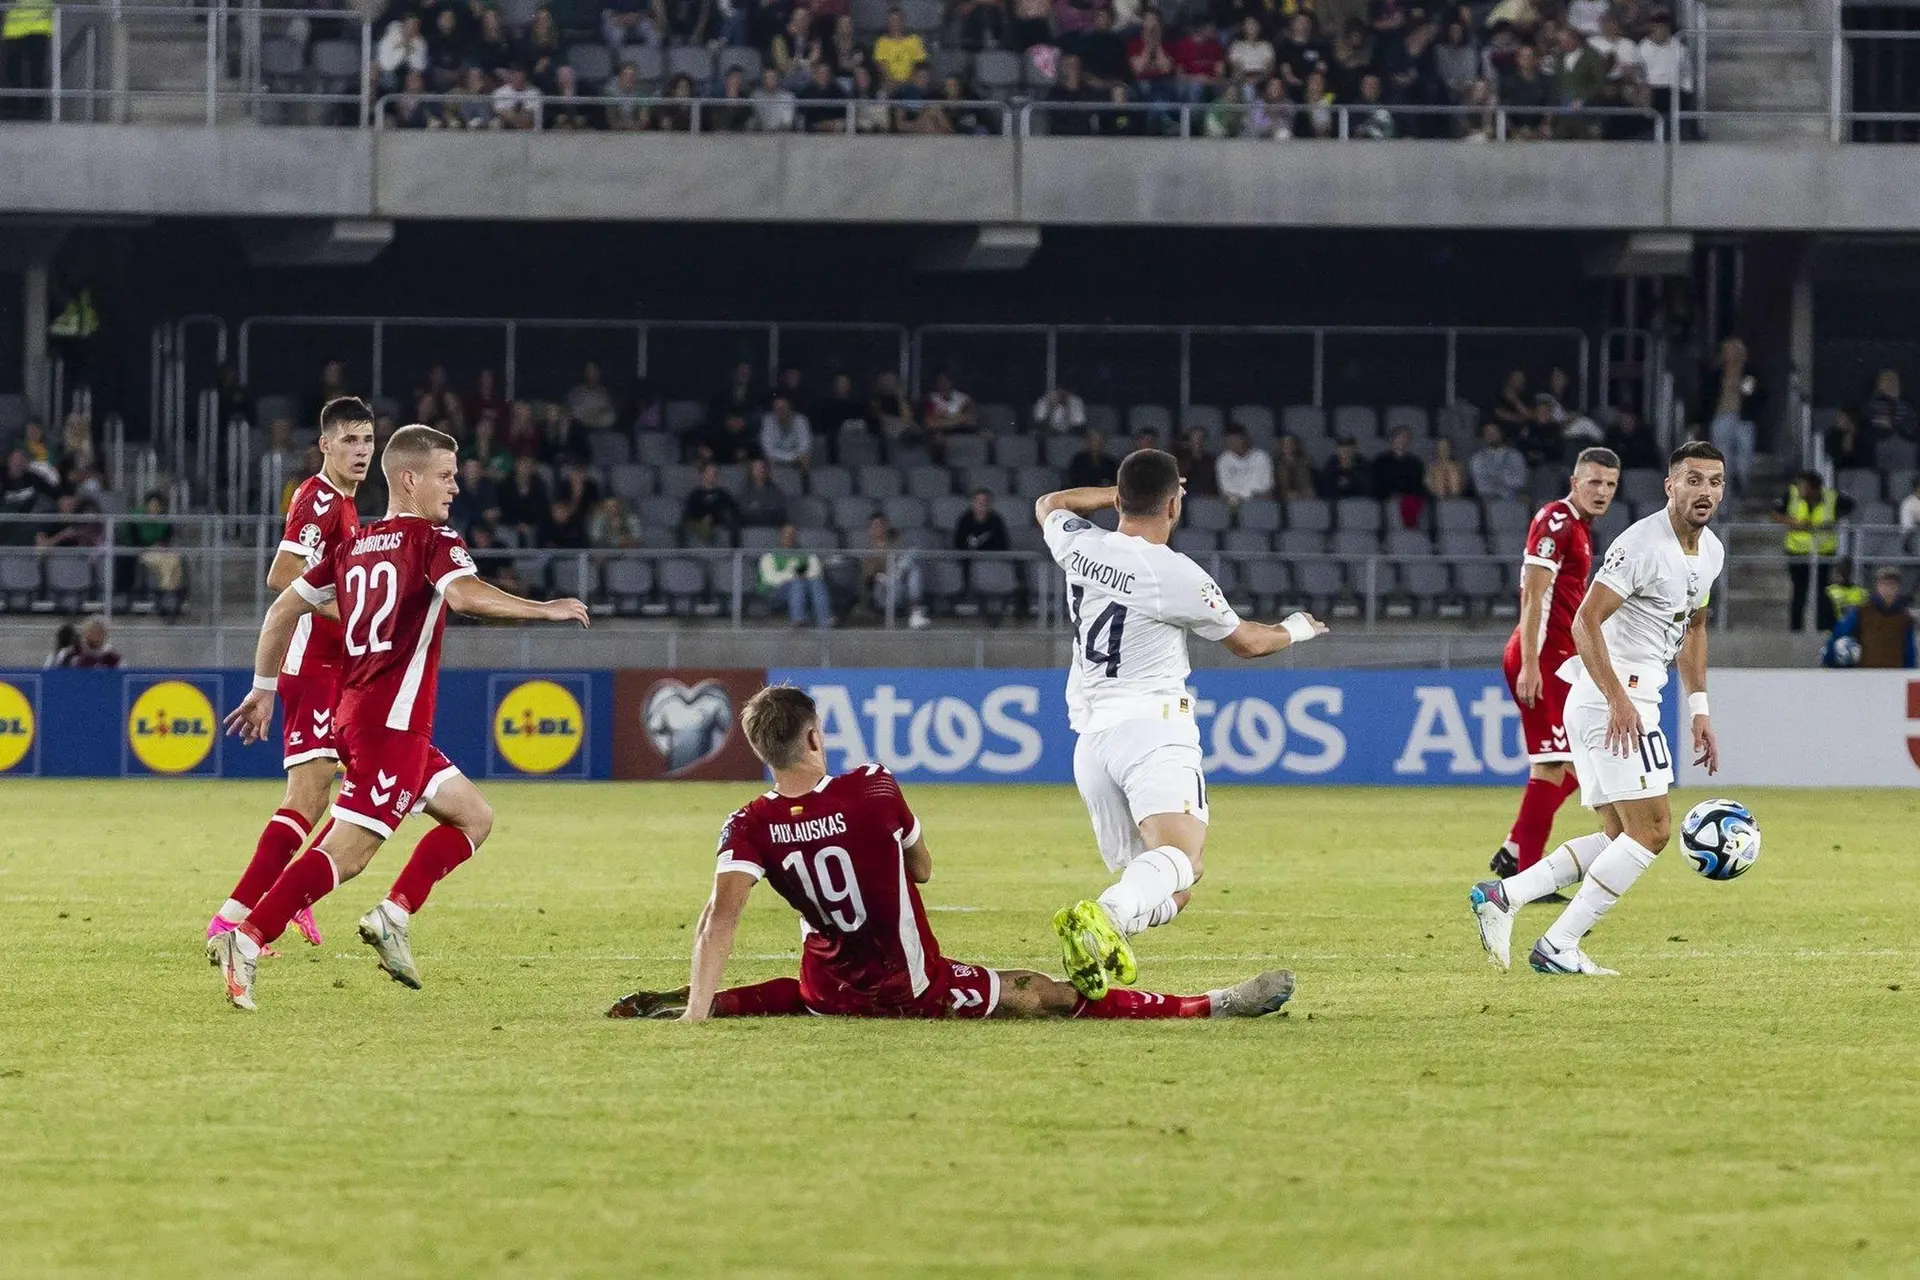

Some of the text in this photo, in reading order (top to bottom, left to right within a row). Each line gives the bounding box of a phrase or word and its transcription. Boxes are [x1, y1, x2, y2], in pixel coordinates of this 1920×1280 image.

[345, 561, 397, 656] 22
[1072, 550, 1135, 594] ŽIVKOVIĆ
[1393, 685, 1530, 774] At
[1638, 731, 1669, 773] 10
[782, 846, 867, 932] 19
